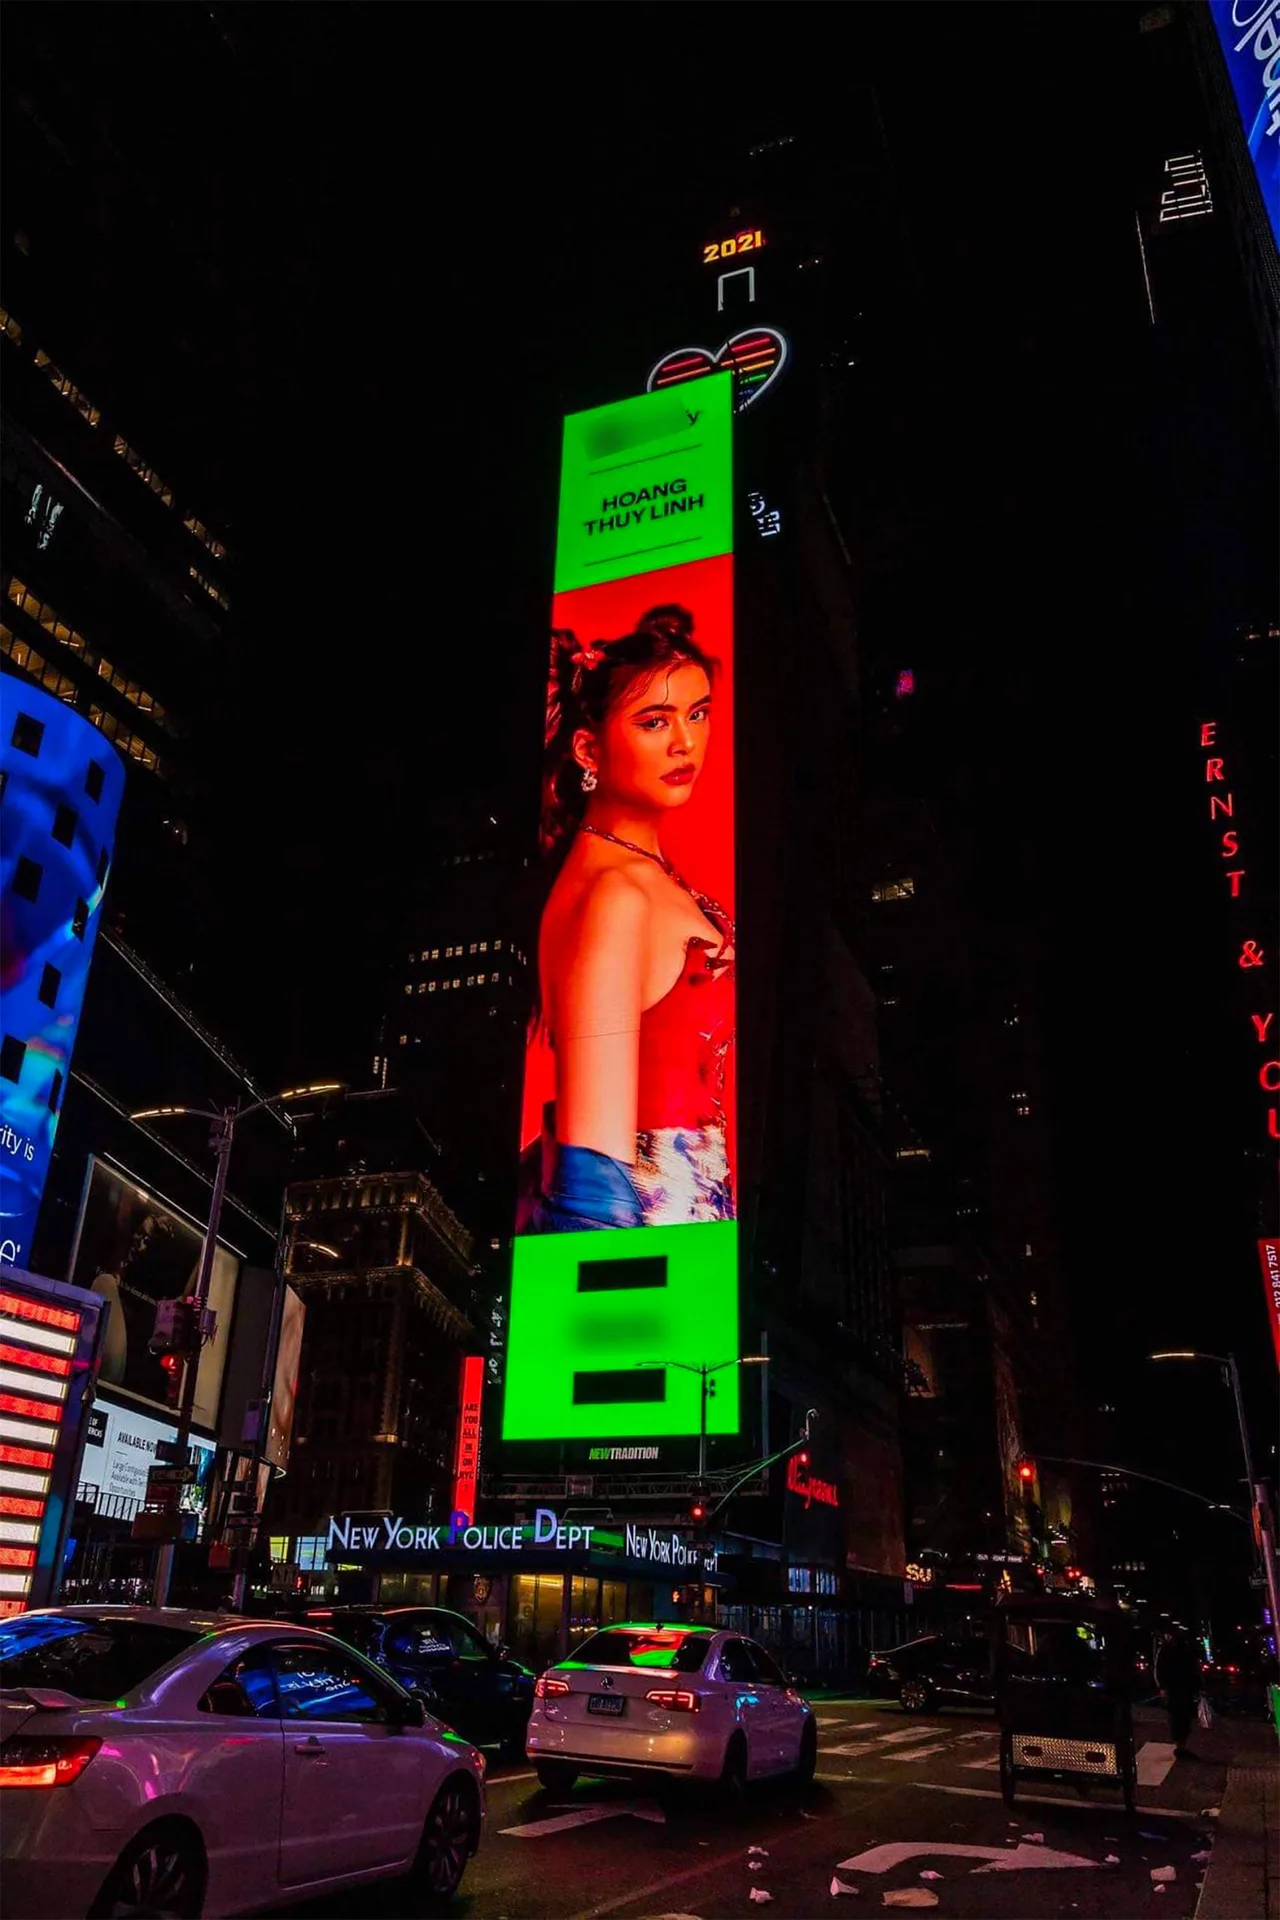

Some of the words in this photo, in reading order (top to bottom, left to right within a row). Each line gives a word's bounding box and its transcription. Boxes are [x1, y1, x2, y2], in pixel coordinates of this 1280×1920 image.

[703, 230, 762, 263] 2021
[602, 478, 687, 512] HOANG
[584, 508, 646, 536] THUY
[650, 493, 705, 521] LINH
[1200, 722, 1246, 897] ERNST
[1239, 940, 1264, 968] &
[24, 1137, 35, 1161] is
[118, 1431, 146, 1450] AVAILABLE
[383, 1516, 440, 1550] YORK
[448, 1510, 522, 1550] POLICE
[535, 1508, 595, 1550] DEPT
